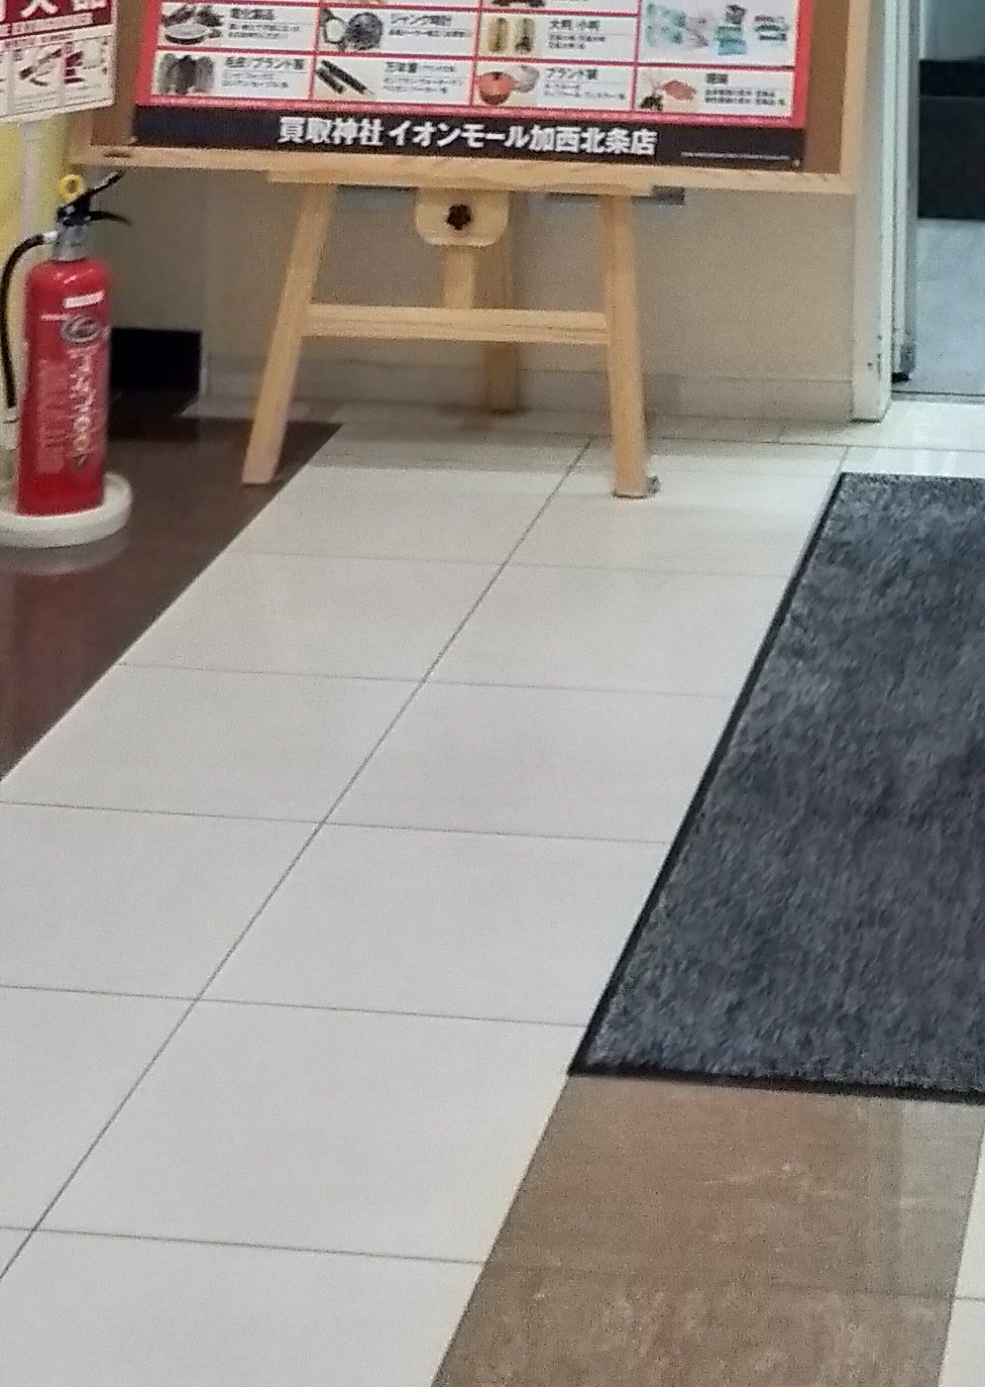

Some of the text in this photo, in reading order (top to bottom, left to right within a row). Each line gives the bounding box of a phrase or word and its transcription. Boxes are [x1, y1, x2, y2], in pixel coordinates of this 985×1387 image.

[276, 116, 658, 156] 買取神社 イオンモール加西北条店
